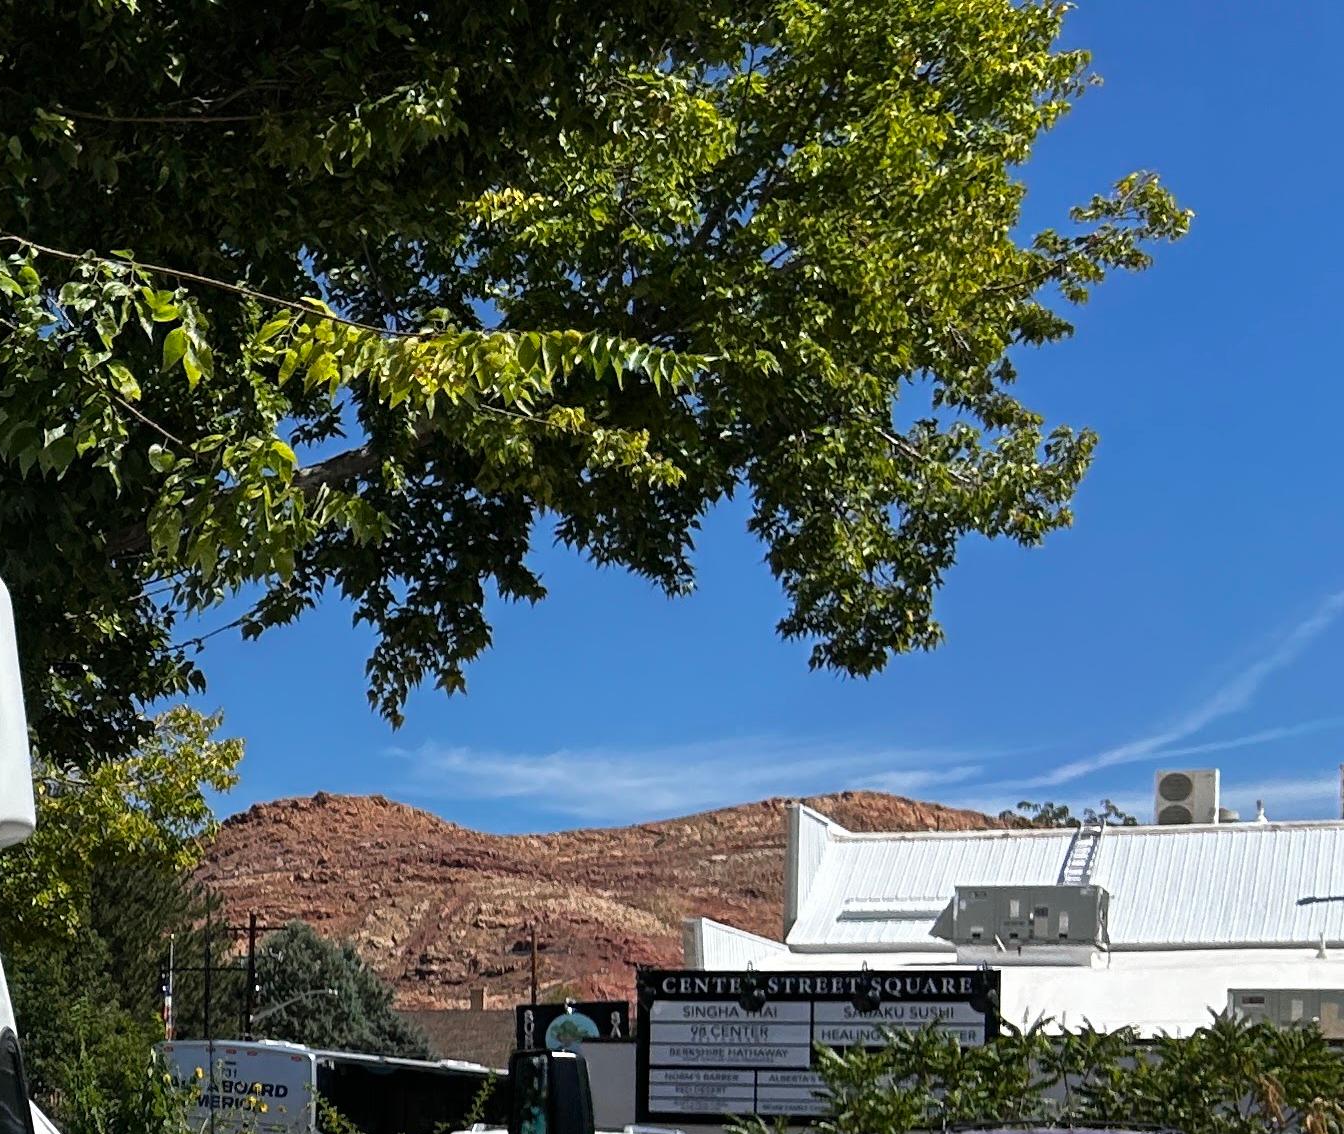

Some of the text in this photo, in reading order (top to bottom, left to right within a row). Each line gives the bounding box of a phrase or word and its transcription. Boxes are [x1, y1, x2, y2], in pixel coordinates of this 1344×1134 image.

[768, 976, 860, 995] STREET
[870, 976, 973, 998] SQUARE
[683, 1005, 739, 1018] SINGHA
[909, 1006, 954, 1019] SUSHI
[710, 1026, 769, 1039] CENTER
[821, 1028, 880, 1041] HEALING
[727, 1048, 788, 1058] HATHAWAY
